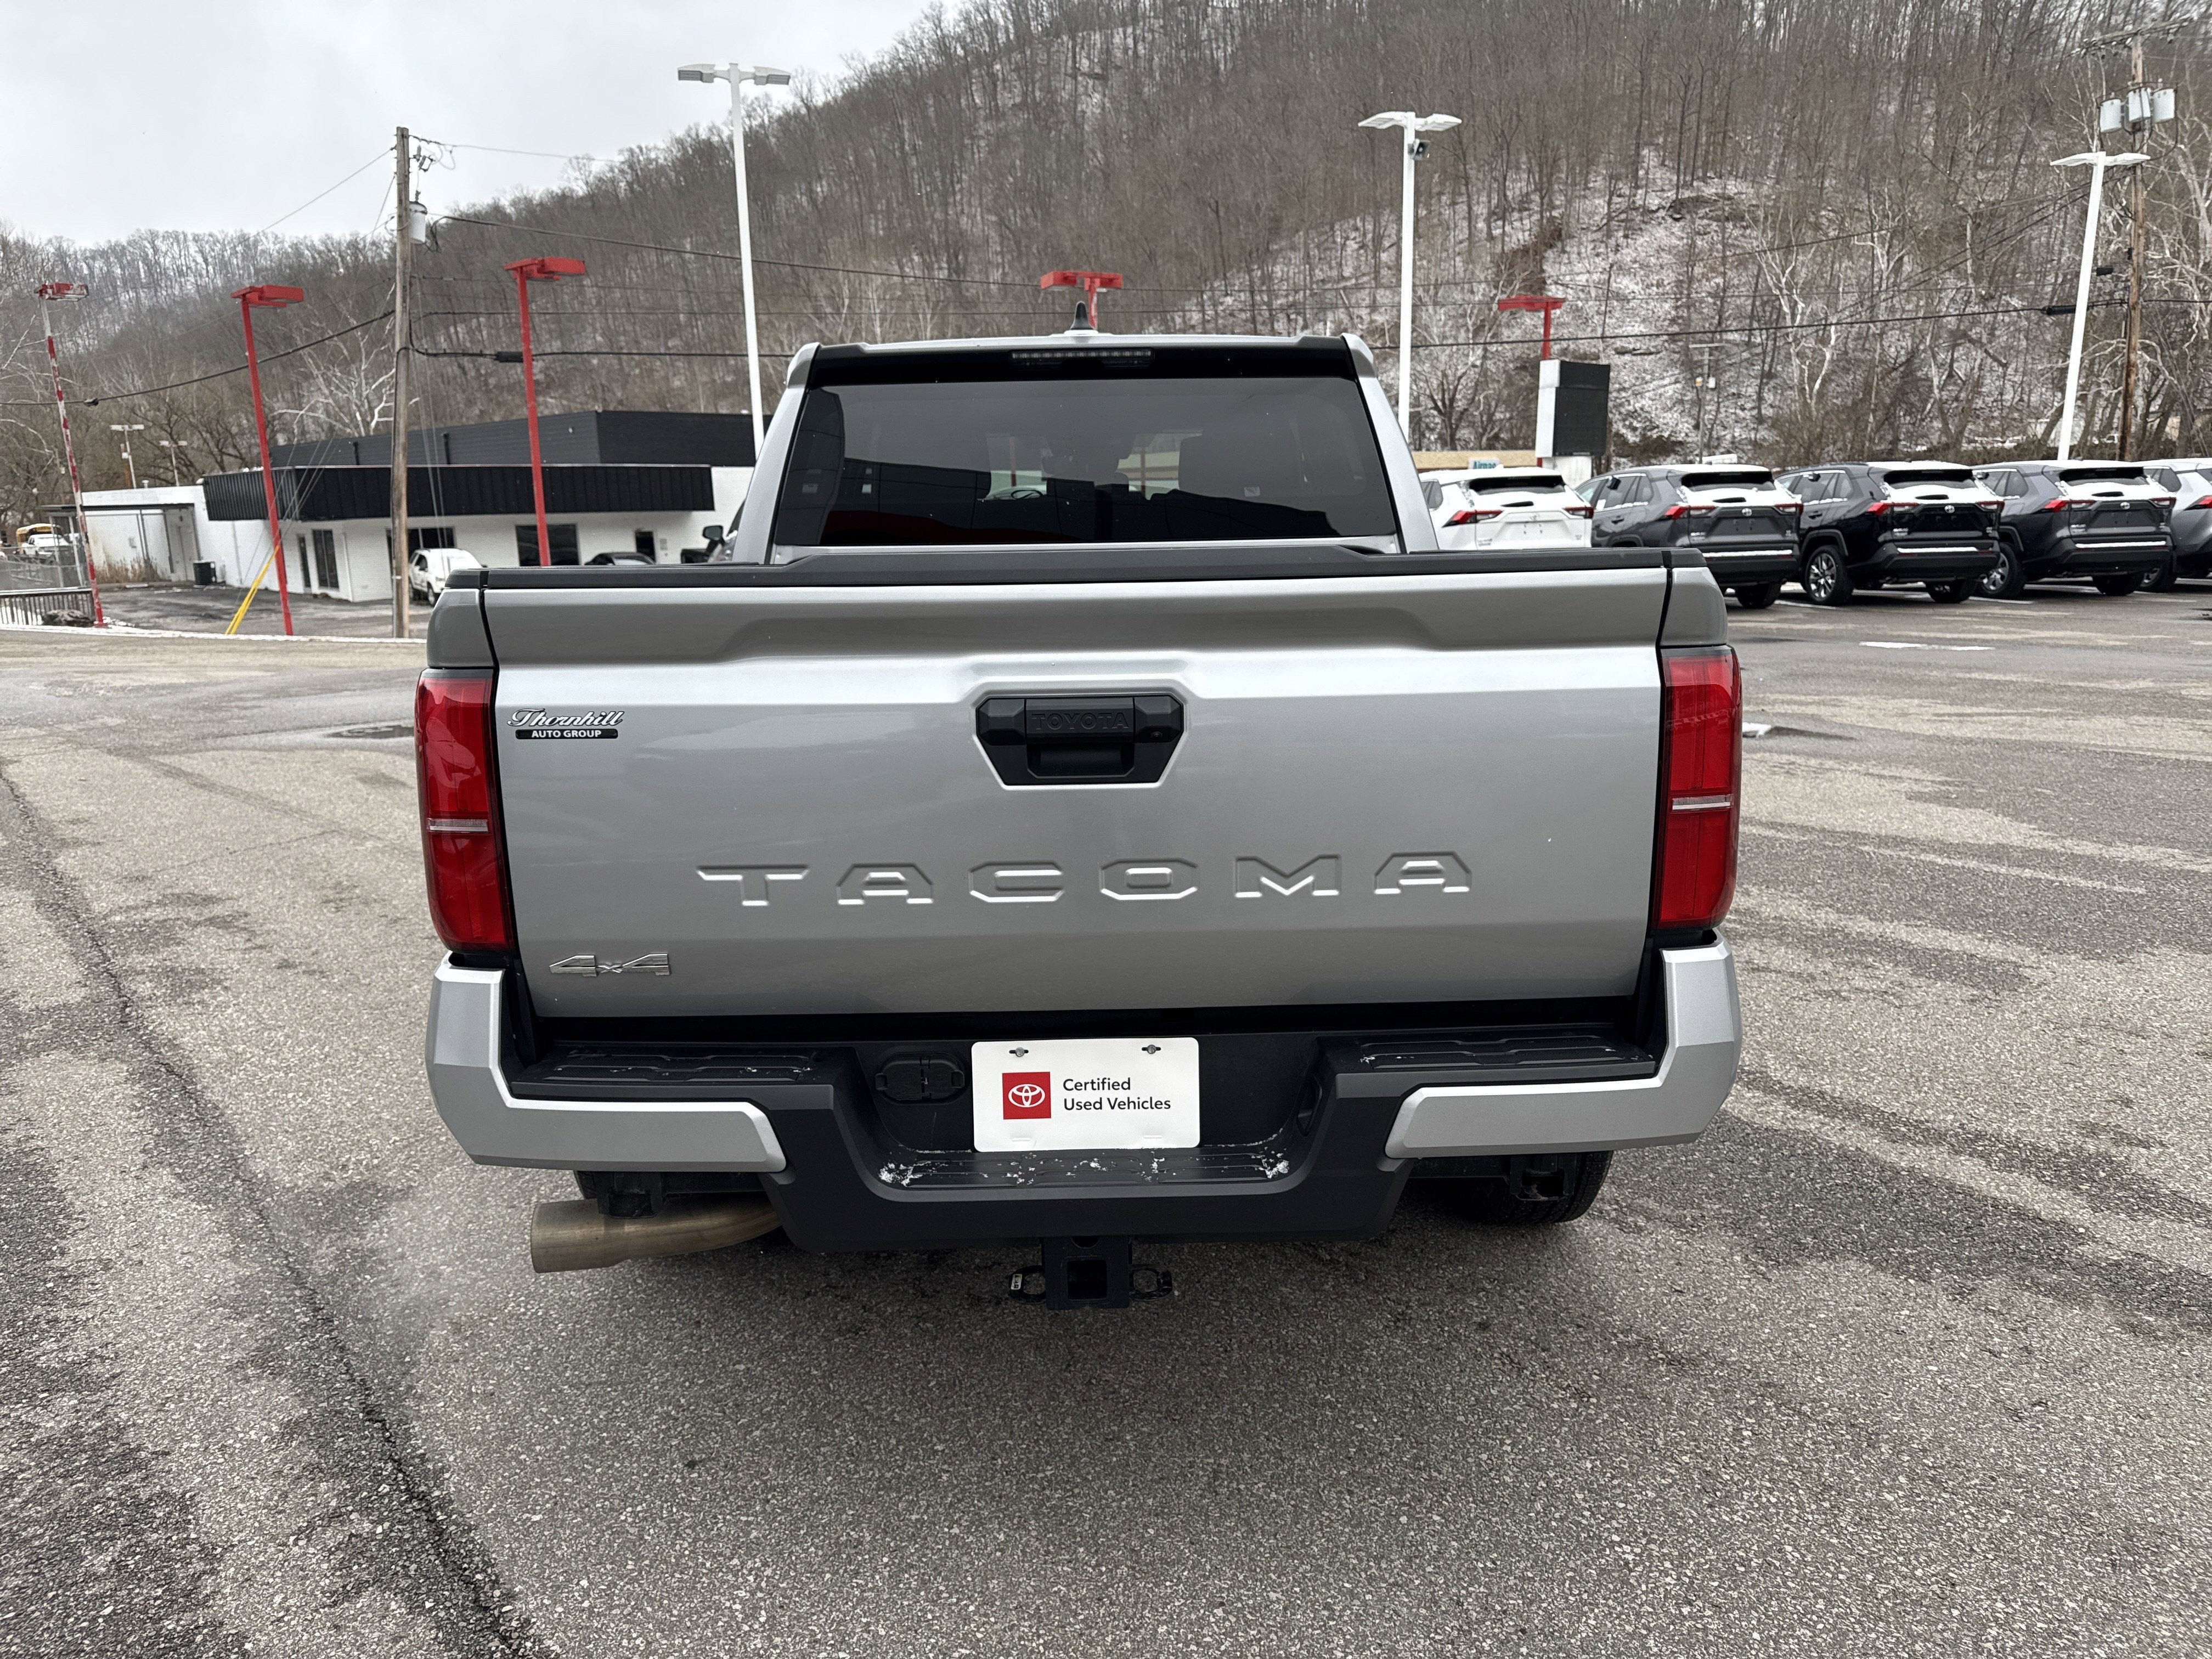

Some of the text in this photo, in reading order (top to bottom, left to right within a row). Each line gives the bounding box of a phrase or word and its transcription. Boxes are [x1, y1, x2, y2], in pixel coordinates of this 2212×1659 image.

[506, 708, 625, 727] Thornhill
[1031, 713, 1130, 731] TOYOTA
[697, 851, 1472, 906] TACOMA
[1063, 1077, 1131, 1091] Certified
[1064, 1096, 1171, 1110] Used Vehicles
